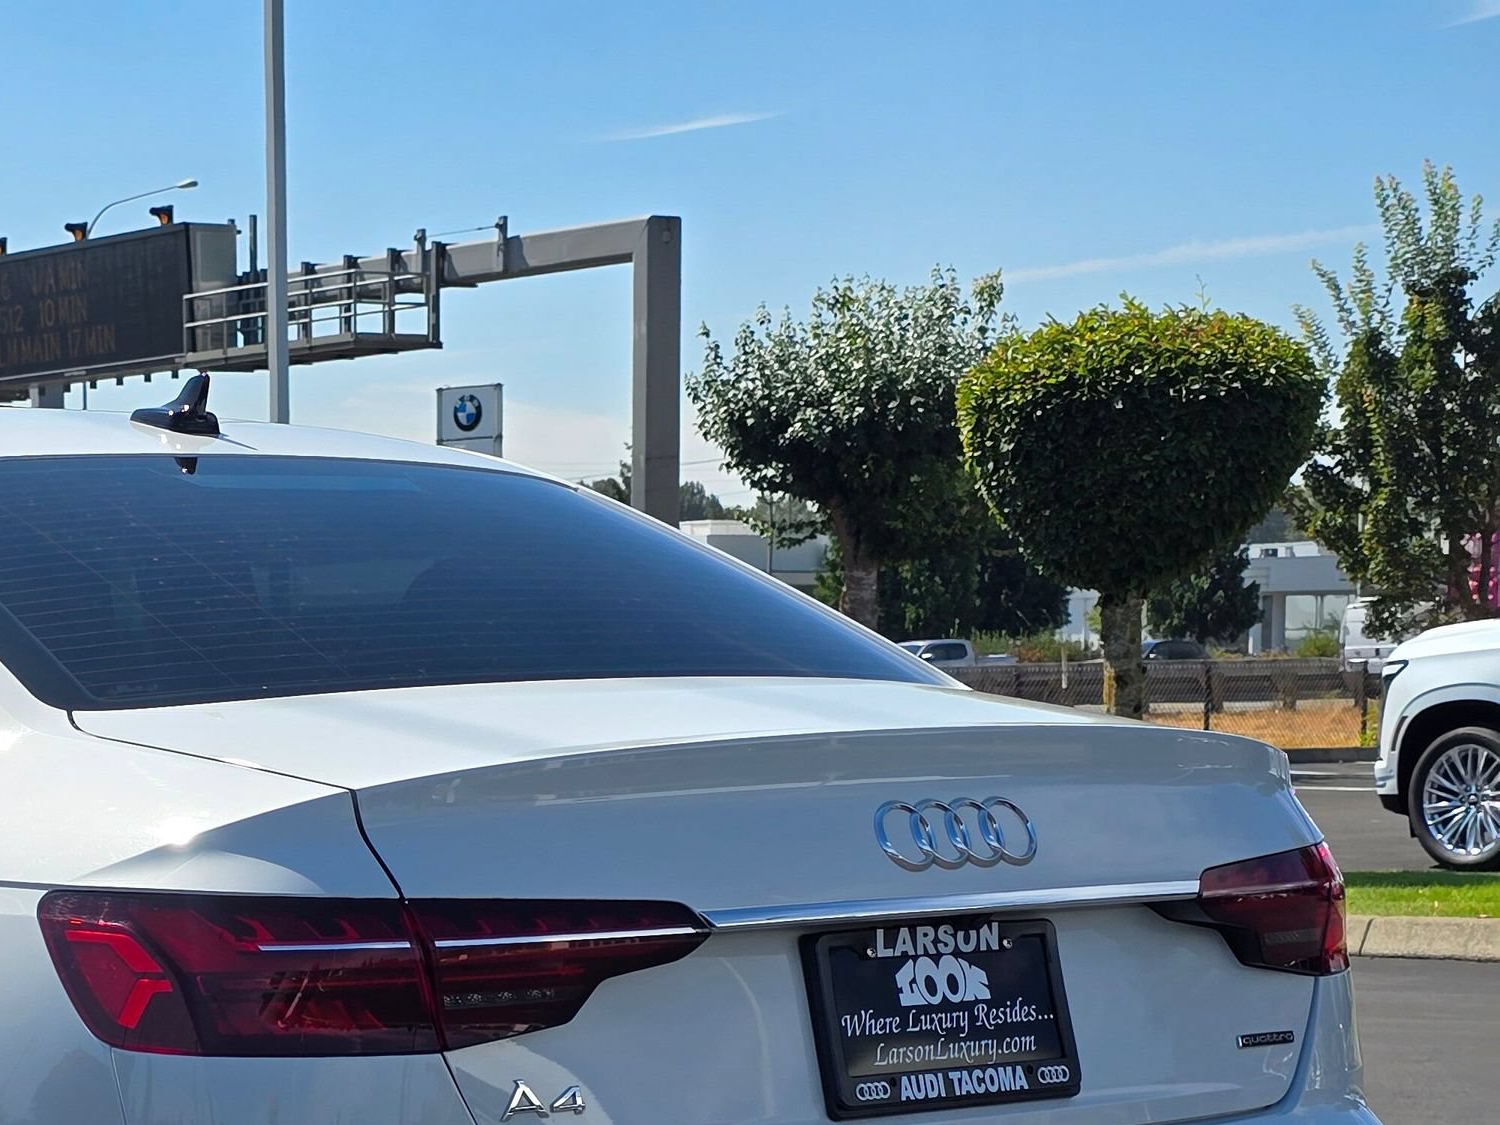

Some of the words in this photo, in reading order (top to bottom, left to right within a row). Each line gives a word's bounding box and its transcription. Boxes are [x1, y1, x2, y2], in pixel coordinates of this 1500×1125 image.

[59, 259, 88, 291] MIN
[39, 299, 56, 328] 10
[59, 294, 88, 323] MIN
[68, 328, 82, 358] 17
[86, 323, 117, 353] MIN
[876, 922, 1000, 958] LARSON
[841, 1009, 901, 1038] Where
[907, 1009, 969, 1037] Luxury
[975, 997, 1054, 1029] Resides...
[873, 1034, 1037, 1067] LarsonLuxury.com
[1242, 1032, 1294, 1045] quattro
[500, 1079, 586, 1122] A4
[900, 1072, 946, 1101] AUDI
[948, 1066, 1029, 1097] TACOMA
